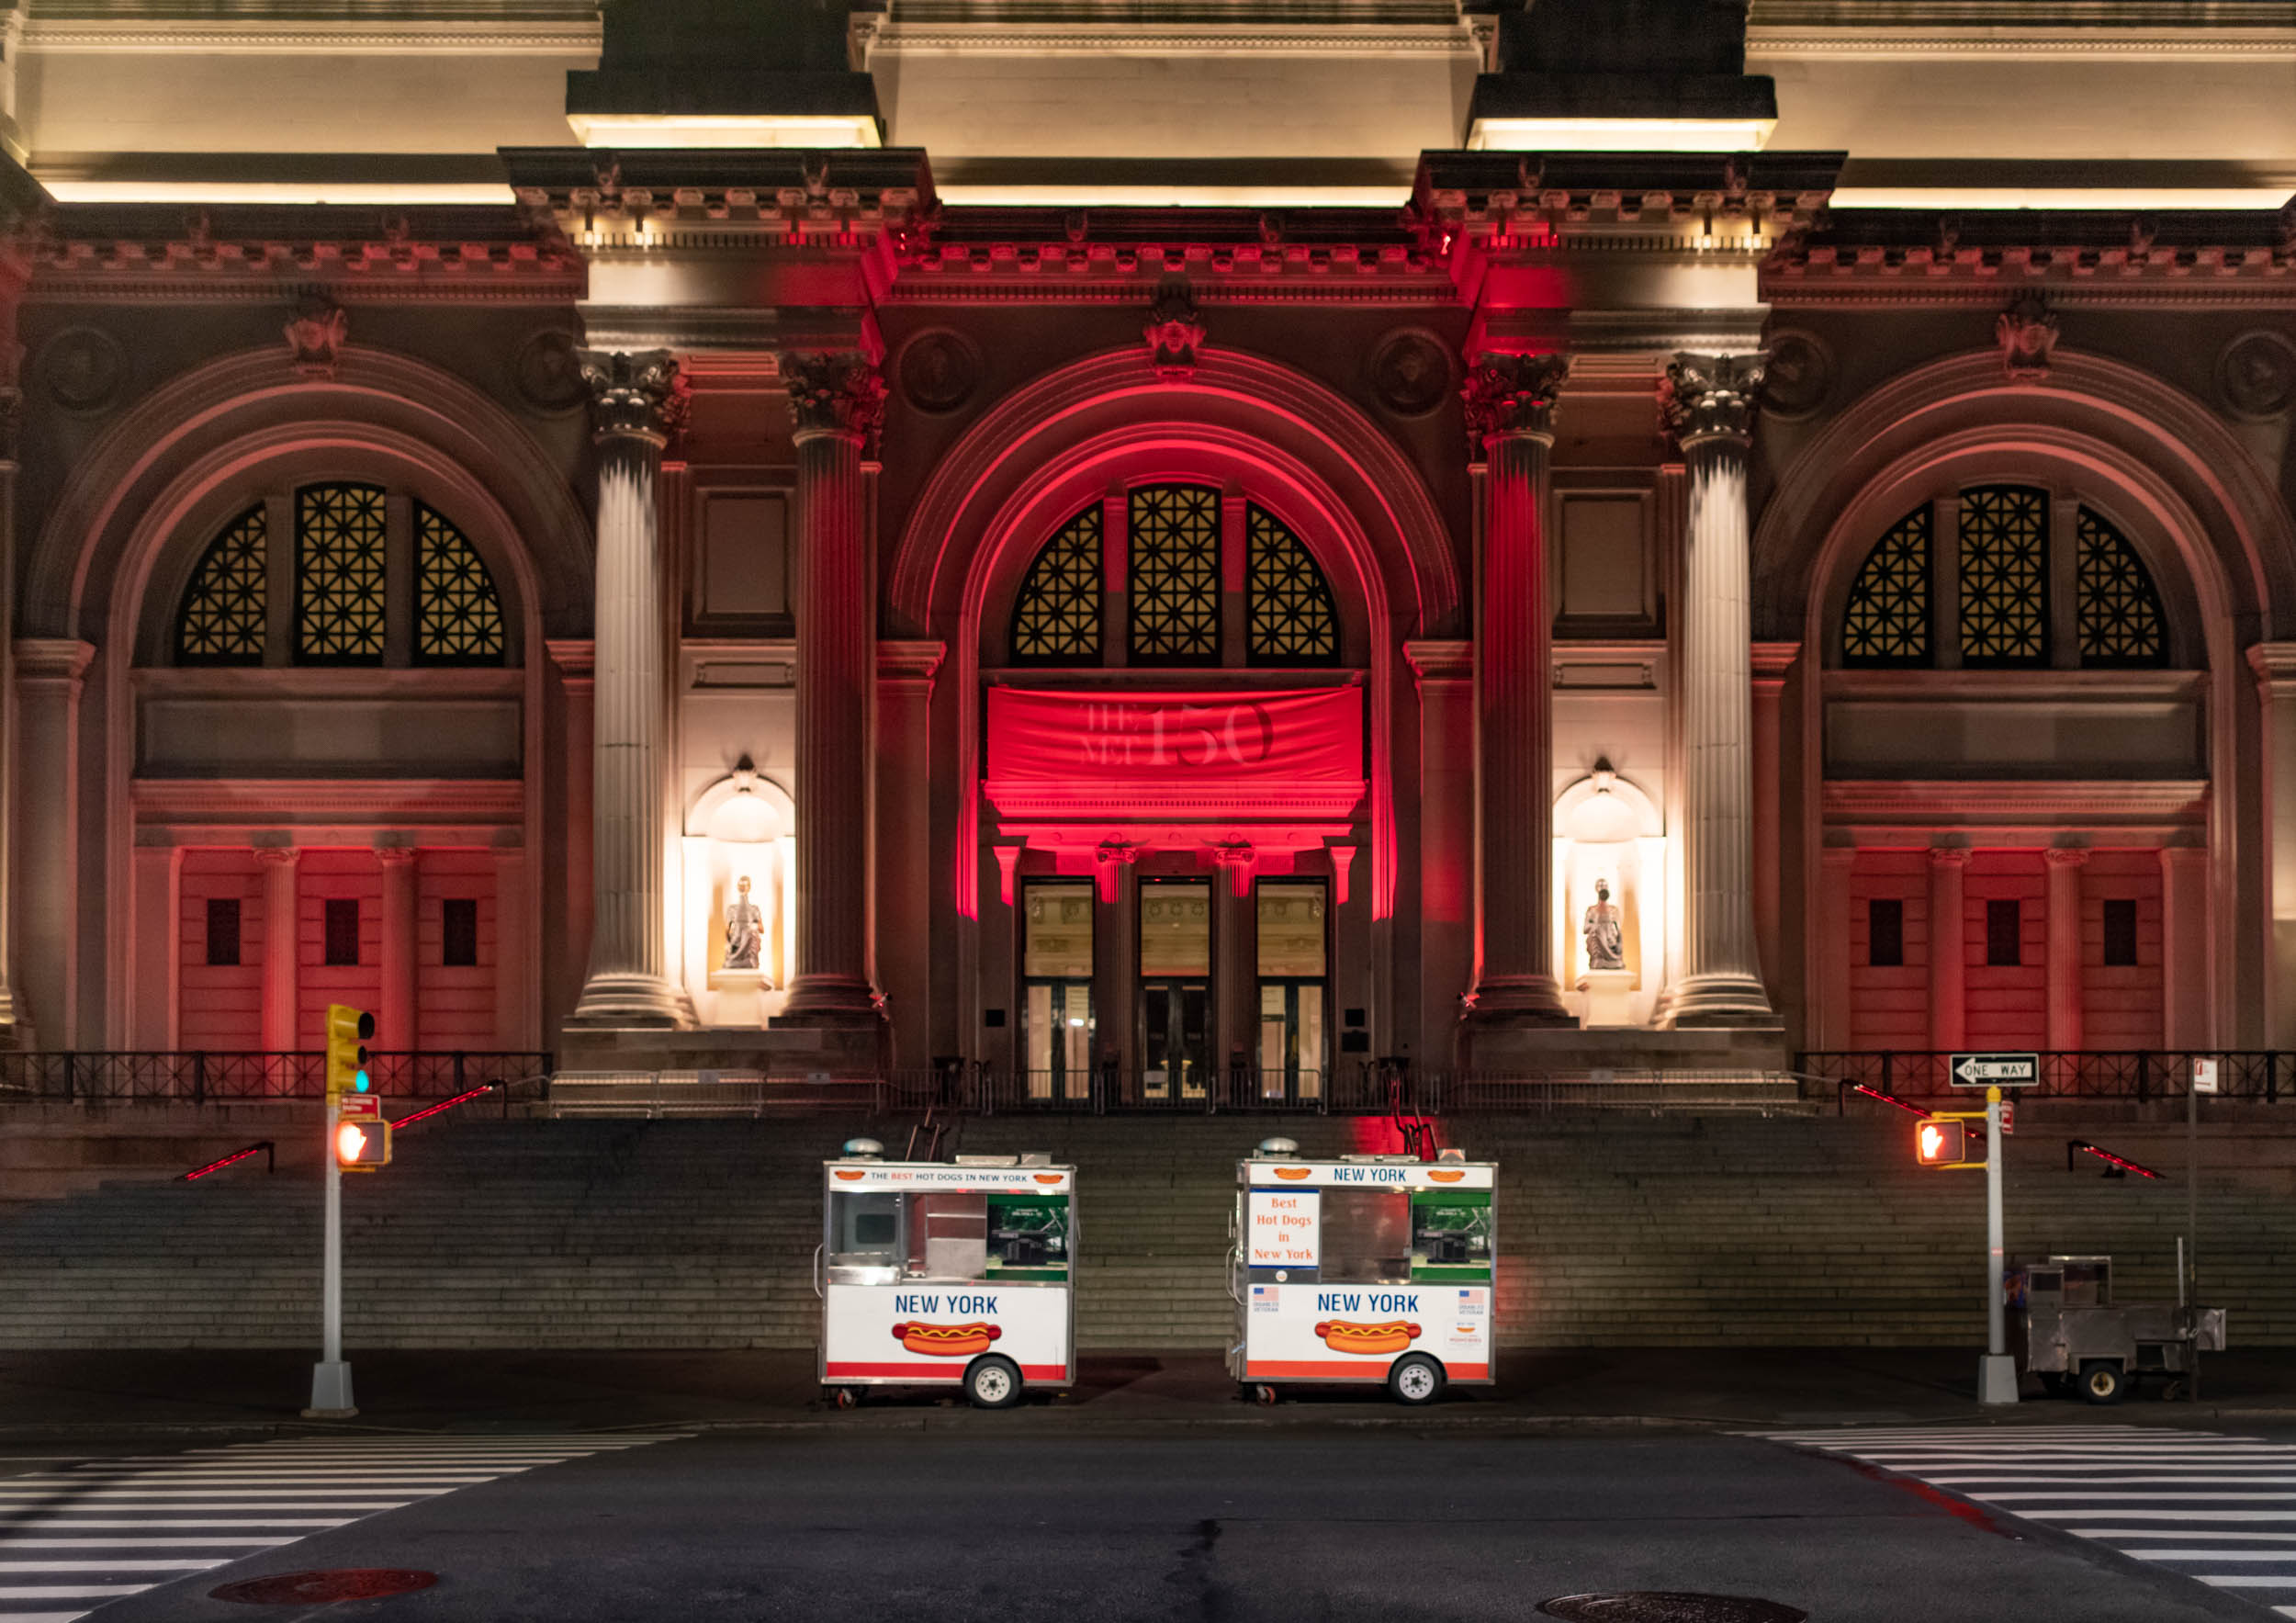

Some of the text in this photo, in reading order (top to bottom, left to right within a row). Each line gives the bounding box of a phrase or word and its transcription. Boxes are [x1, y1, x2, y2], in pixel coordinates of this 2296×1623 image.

[1079, 704, 1139, 731] THE
[1145, 702, 1273, 766] 150
[1964, 1065, 2027, 1076] ONE WAY
[871, 1172, 889, 1180] THE
[916, 1173, 935, 1181] HOT
[965, 1174, 976, 1182] IN
[1334, 1167, 1406, 1182] NEW YORK
[1271, 1197, 1298, 1208] Best
[1256, 1214, 1312, 1228] Hot Dogs
[1277, 1230, 1289, 1242] in
[1255, 1248, 1313, 1259] New York
[895, 1295, 998, 1314] NEW YORK
[1318, 1293, 1419, 1313] NEW YORK
